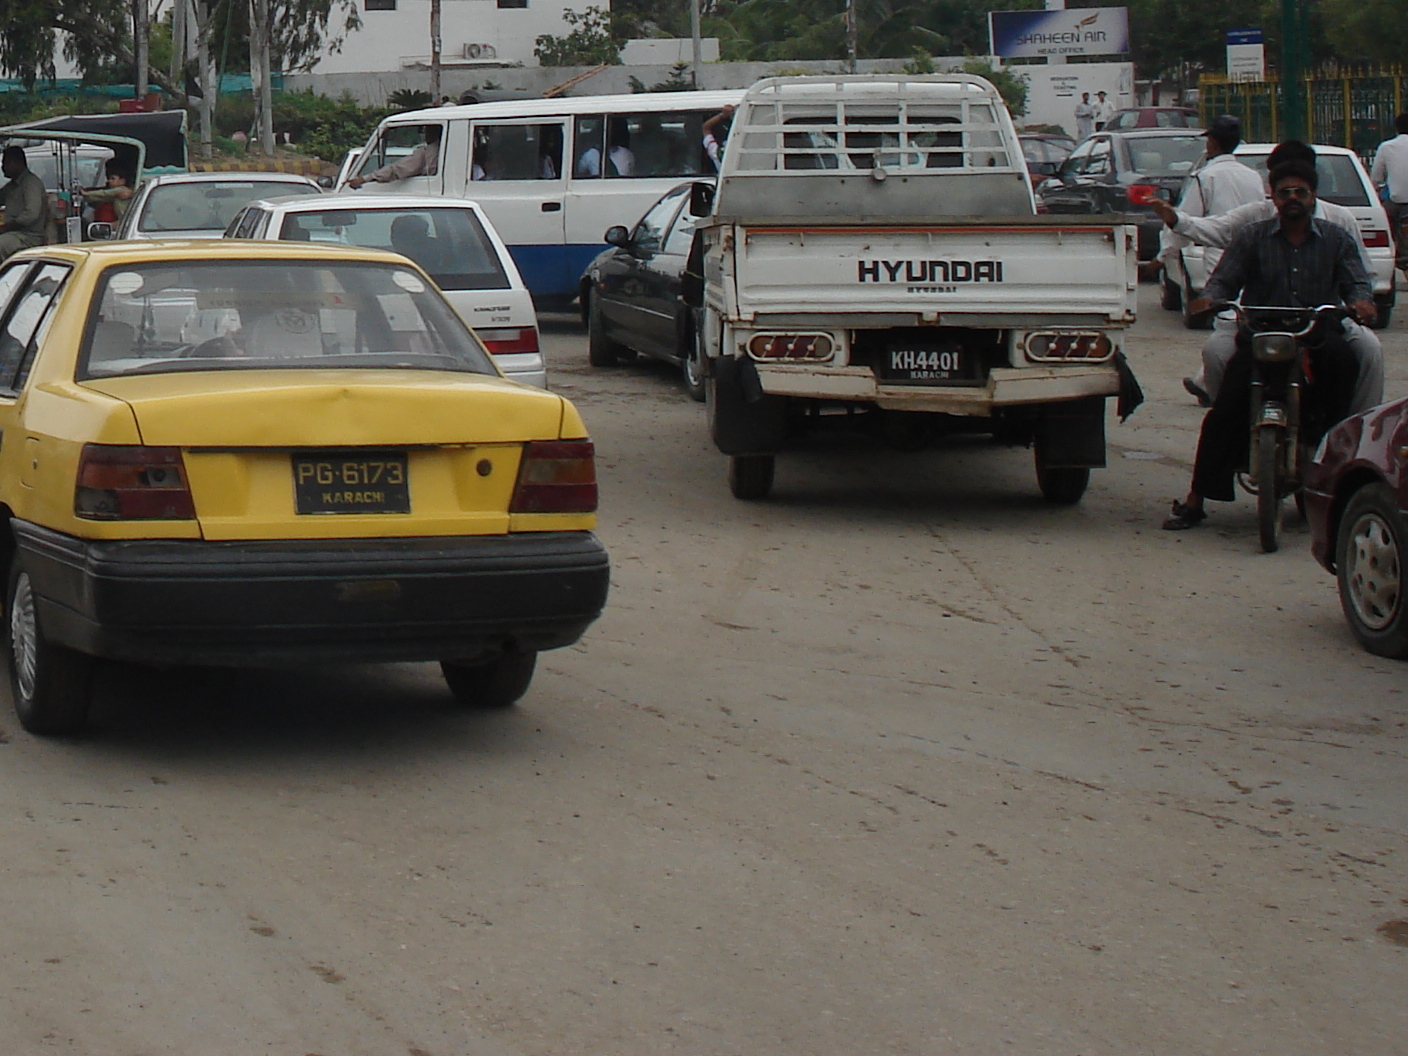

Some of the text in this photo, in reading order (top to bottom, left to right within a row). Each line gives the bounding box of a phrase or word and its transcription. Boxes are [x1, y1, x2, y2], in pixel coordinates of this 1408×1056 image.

[1017, 31, 1106, 45] SHAHEEN AIR
[858, 260, 1003, 282] HYUNDAI
[322, 491, 385, 503] KARACHI
